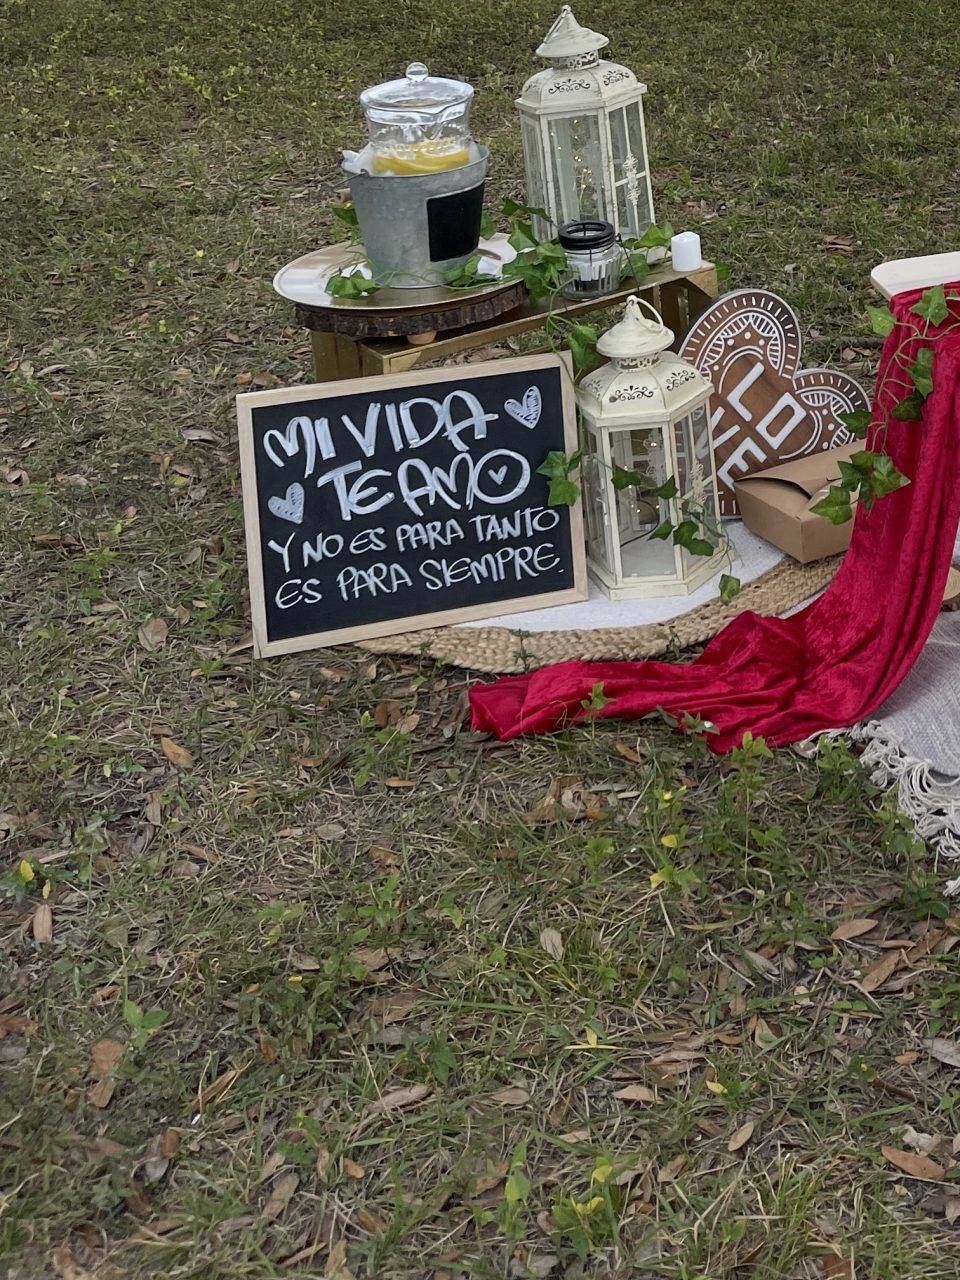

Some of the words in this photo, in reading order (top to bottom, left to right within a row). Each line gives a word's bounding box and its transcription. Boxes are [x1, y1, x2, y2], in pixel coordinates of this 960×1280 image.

[263, 415, 336, 478] MI
[341, 389, 499, 458] VIDA
[267, 532, 297, 573] Y
[303, 533, 344, 567] NO
[350, 527, 387, 554] ES
[396, 518, 464, 552] PARA
[468, 506, 560, 542] TANTO
[275, 578, 322, 609] ES
[336, 562, 413, 602] PARA
